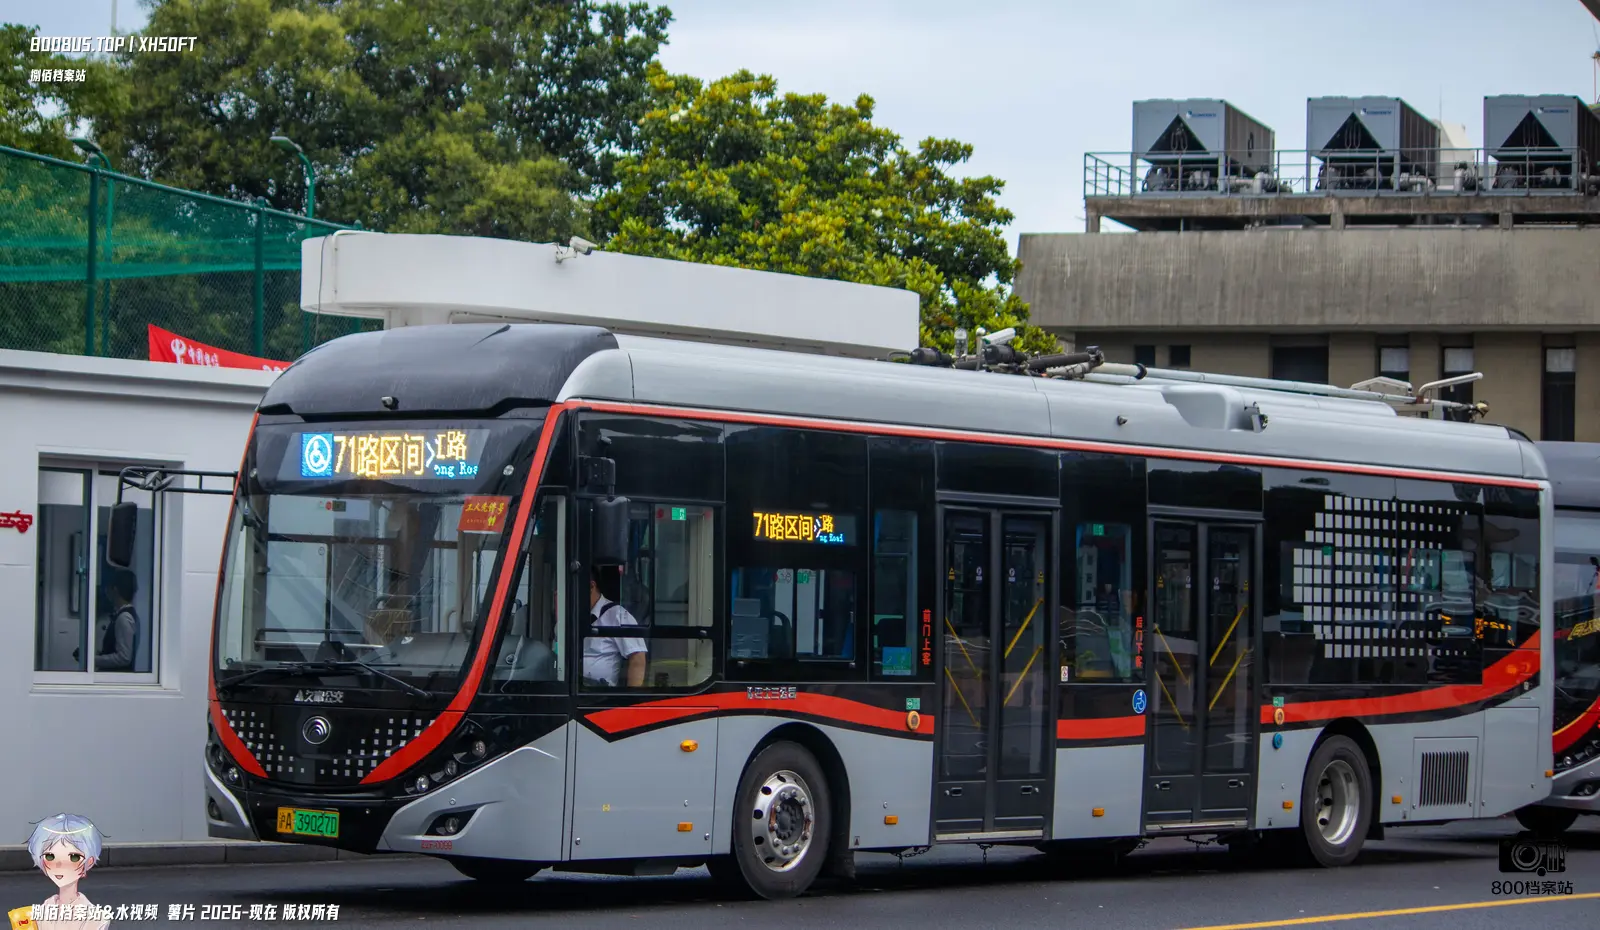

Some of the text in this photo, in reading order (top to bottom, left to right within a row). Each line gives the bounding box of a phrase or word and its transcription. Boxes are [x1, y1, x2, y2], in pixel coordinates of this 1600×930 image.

[333, 434, 425, 477] 71路区间
[753, 512, 814, 541] 71路区间
